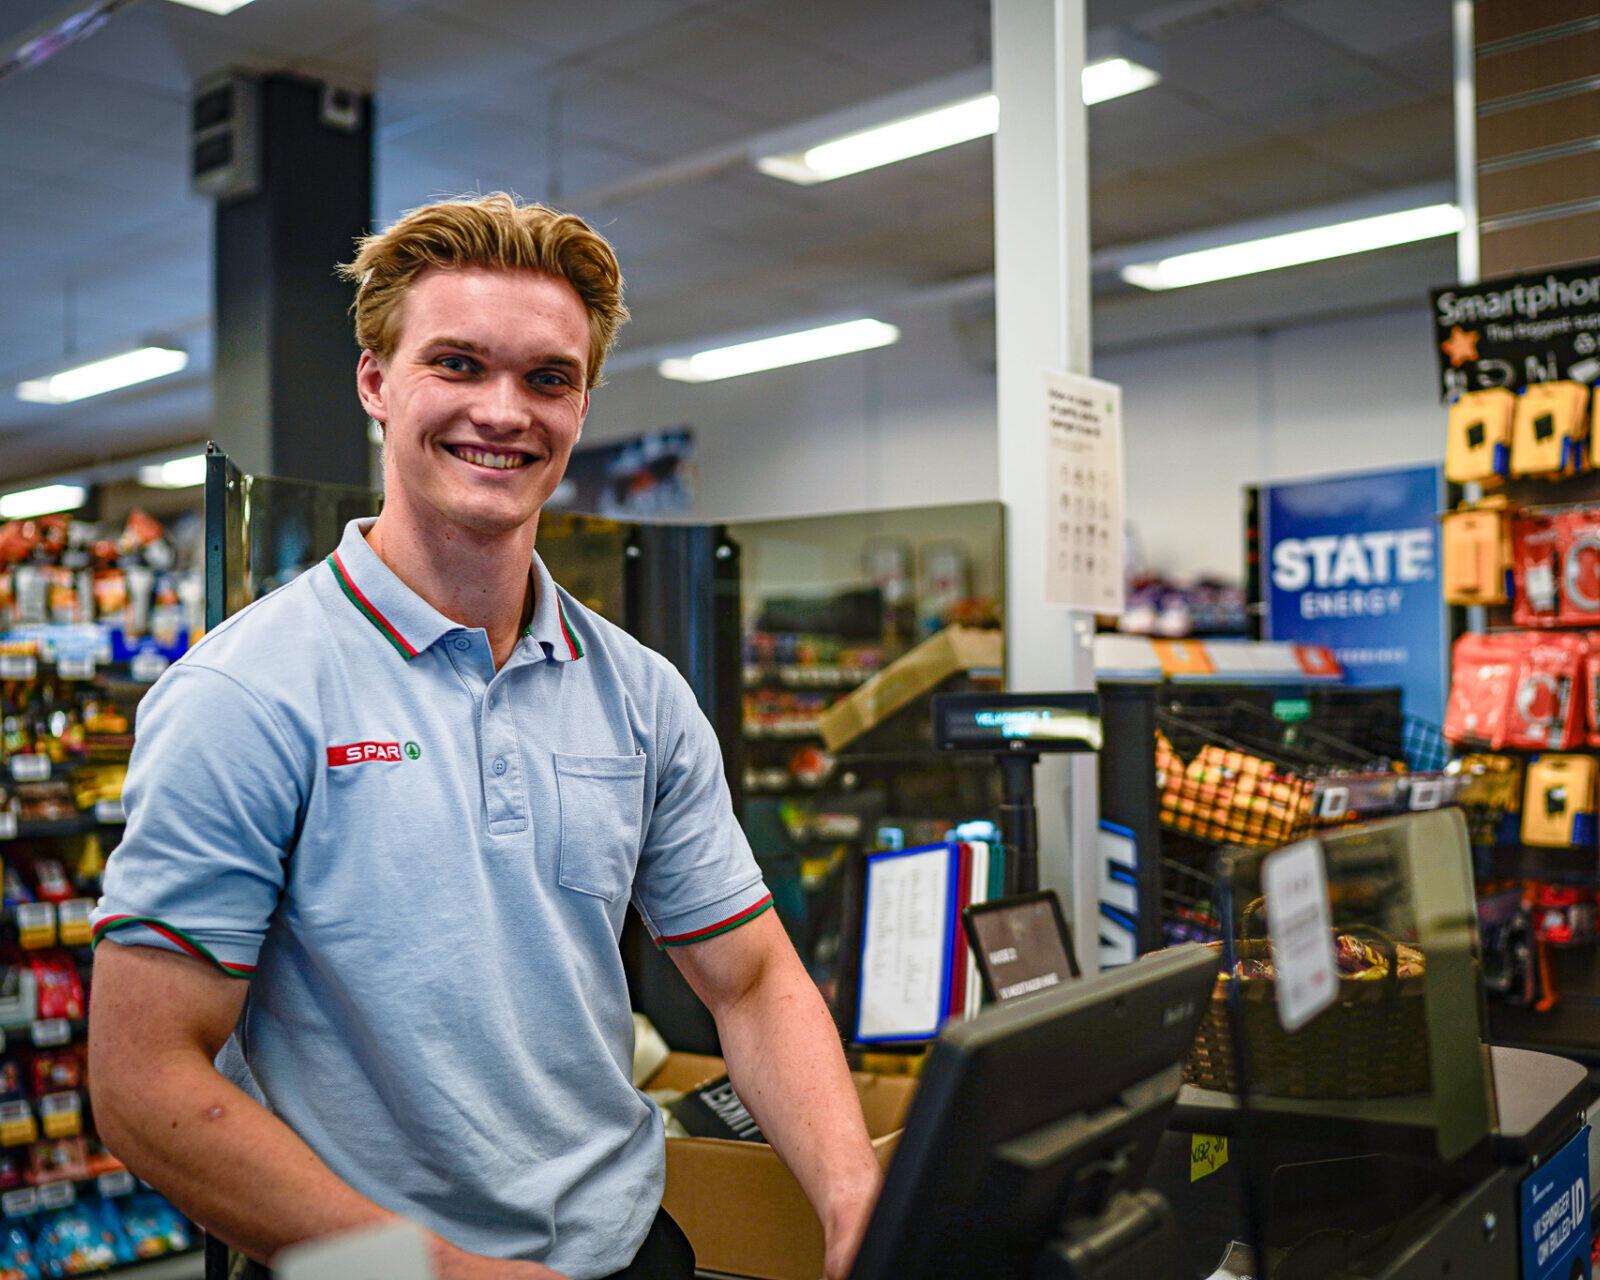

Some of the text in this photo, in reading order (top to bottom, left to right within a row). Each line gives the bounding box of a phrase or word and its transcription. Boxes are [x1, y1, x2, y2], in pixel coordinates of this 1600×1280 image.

[1273, 527, 1433, 591] STATE
[1301, 588, 1403, 620] ENERGY
[346, 744, 401, 761] SPAR
[1571, 1177, 1585, 1231] ID
